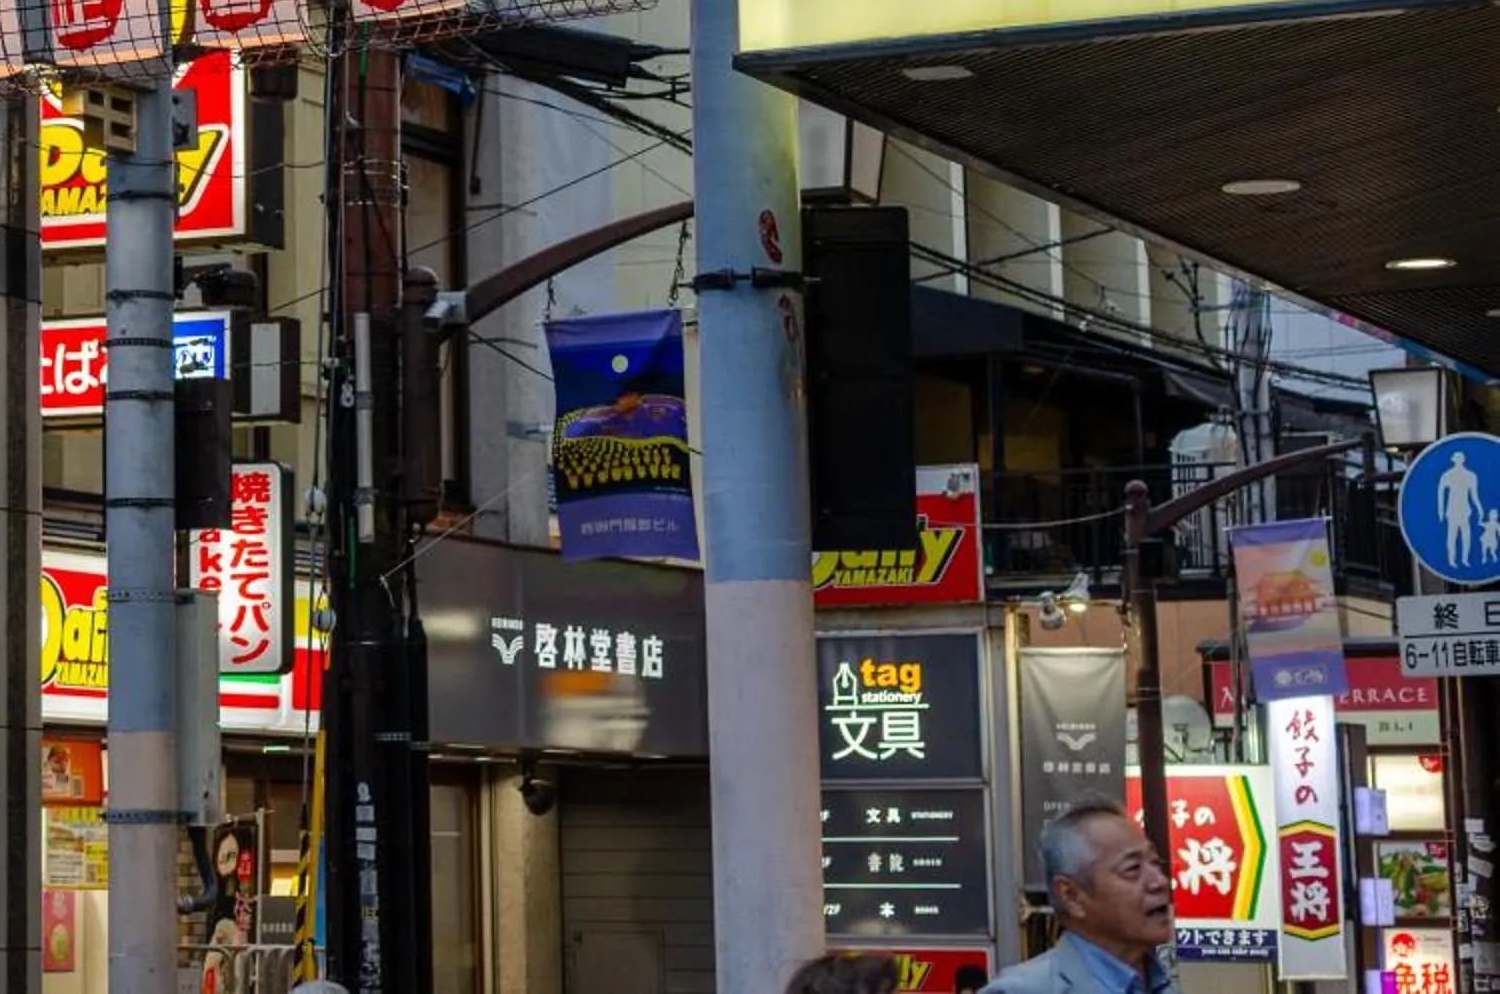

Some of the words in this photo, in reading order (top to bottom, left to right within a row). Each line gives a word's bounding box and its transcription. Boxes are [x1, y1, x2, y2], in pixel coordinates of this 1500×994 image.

[230, 472, 270, 665] 焼きたてパン
[860, 658, 921, 693] tag
[861, 691, 923, 704] stationery
[831, 710, 925, 759] 文具
[1289, 839, 1331, 923] 王将
